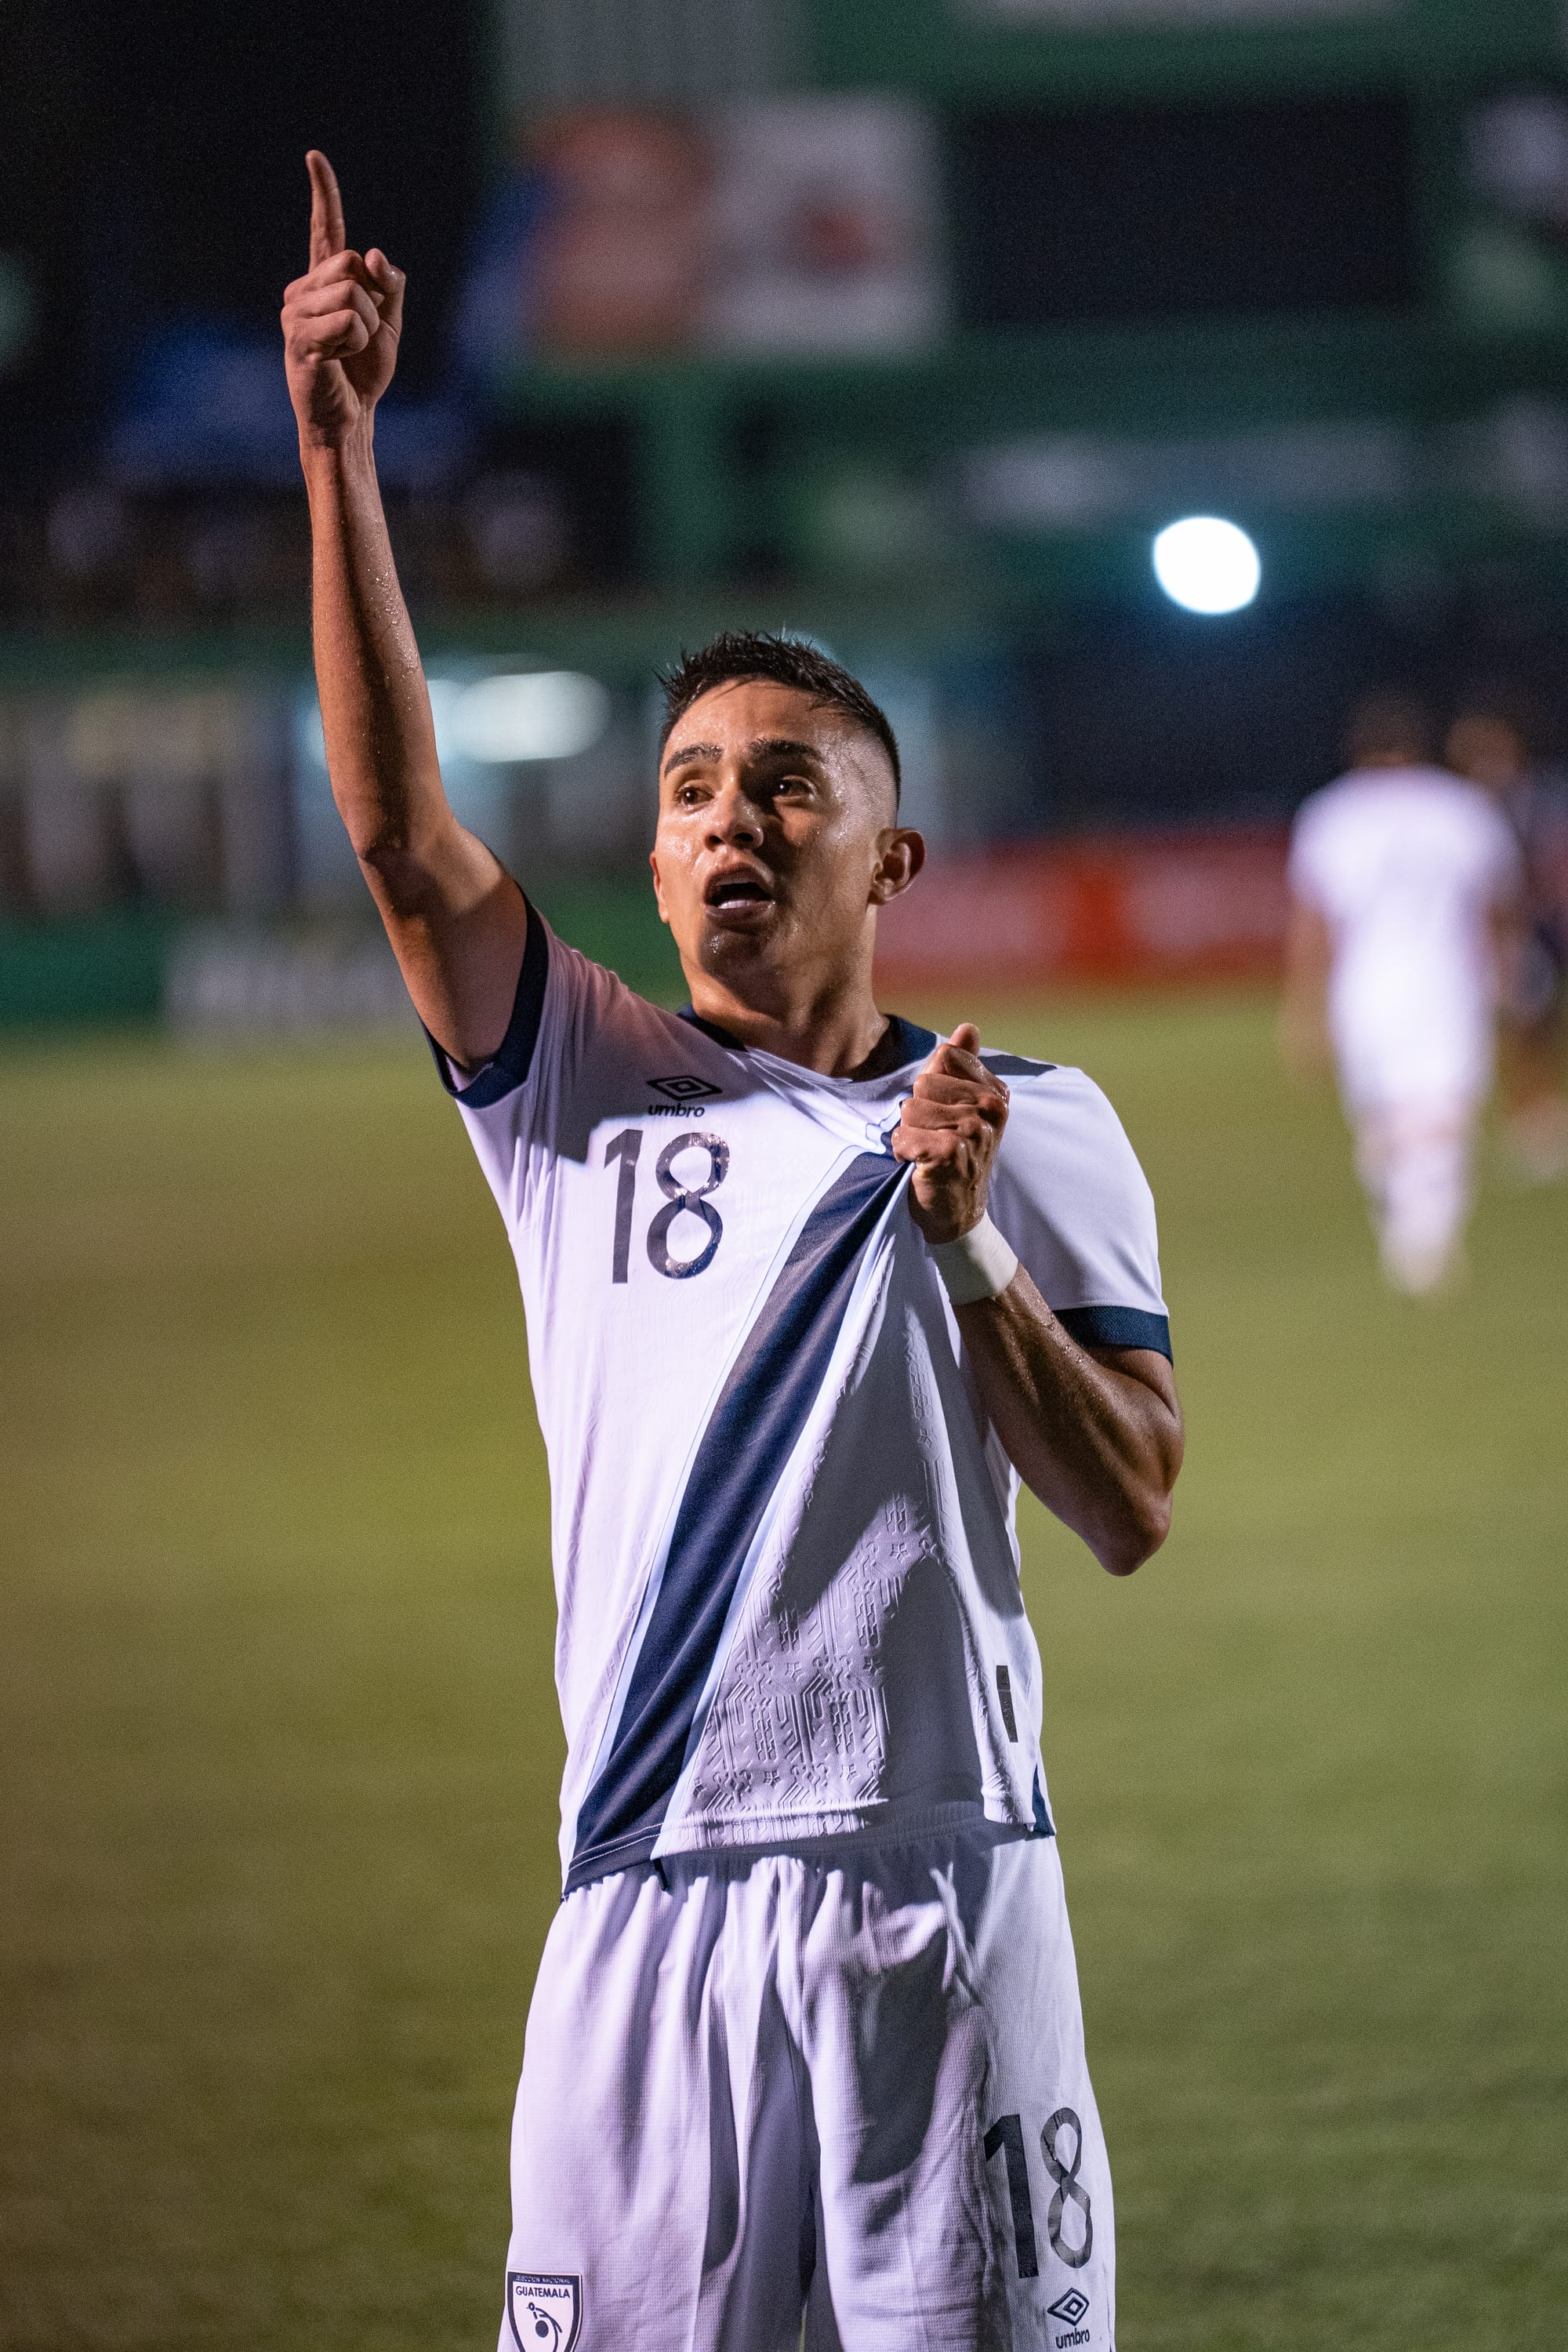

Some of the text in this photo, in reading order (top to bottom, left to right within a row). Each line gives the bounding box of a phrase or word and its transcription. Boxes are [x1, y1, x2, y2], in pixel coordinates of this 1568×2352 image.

[648, 1102, 705, 1118] umbro
[604, 1129, 731, 1284] 18
[983, 2107, 1094, 2279] 18
[515, 2285, 571, 2299] GUATEMALA
[1055, 2327, 1091, 2349] umbro
